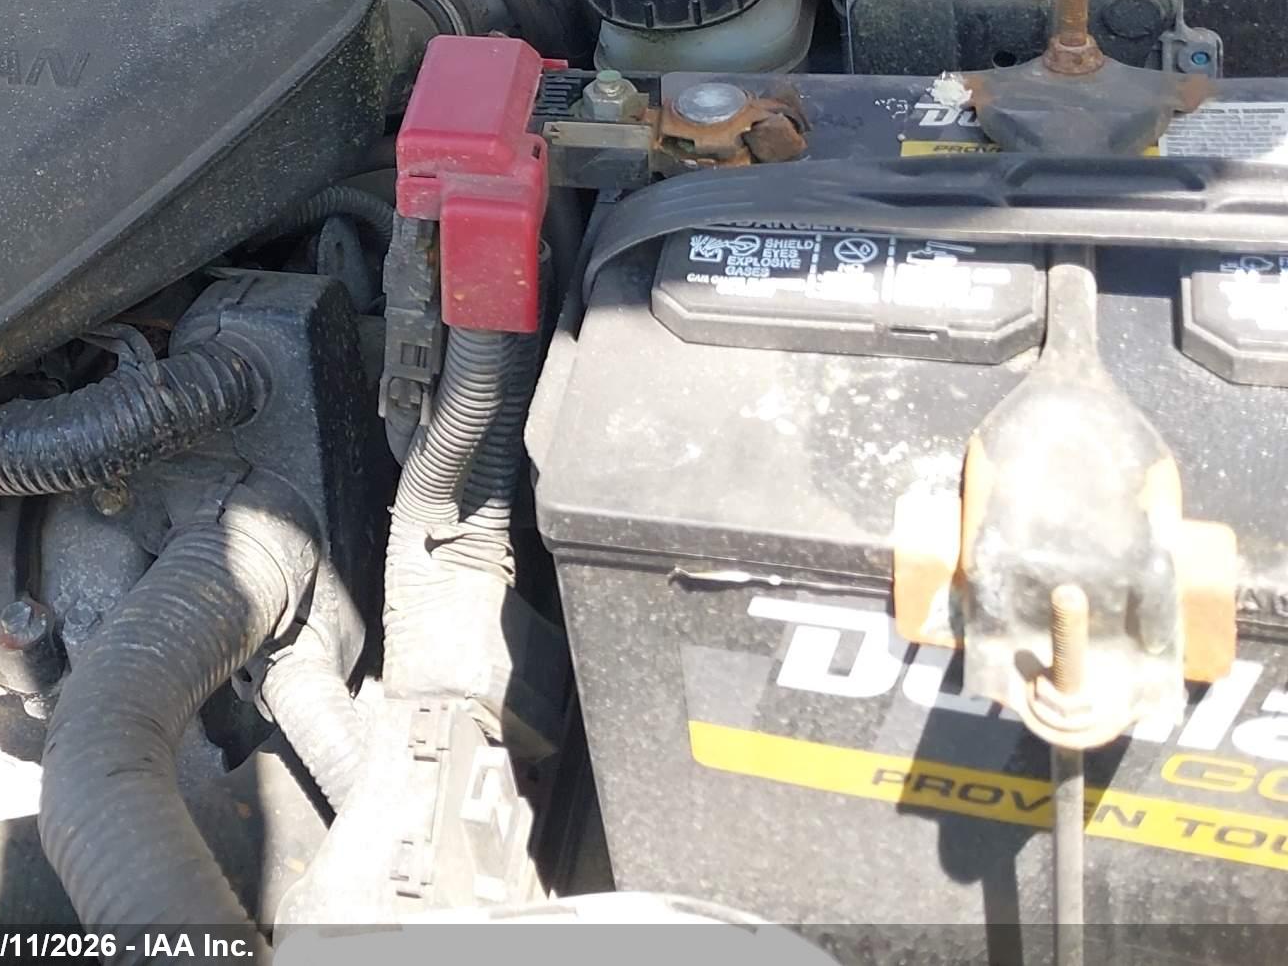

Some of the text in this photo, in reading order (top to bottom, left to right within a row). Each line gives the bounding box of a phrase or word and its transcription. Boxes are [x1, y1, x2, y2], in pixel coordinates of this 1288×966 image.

[764, 237, 815, 250] SHIELD
[762, 248, 799, 259] EYES
[726, 255, 802, 269] EXPLOSIVE
[725, 265, 770, 278] GASES
[870, 768, 1148, 832] PROVN
